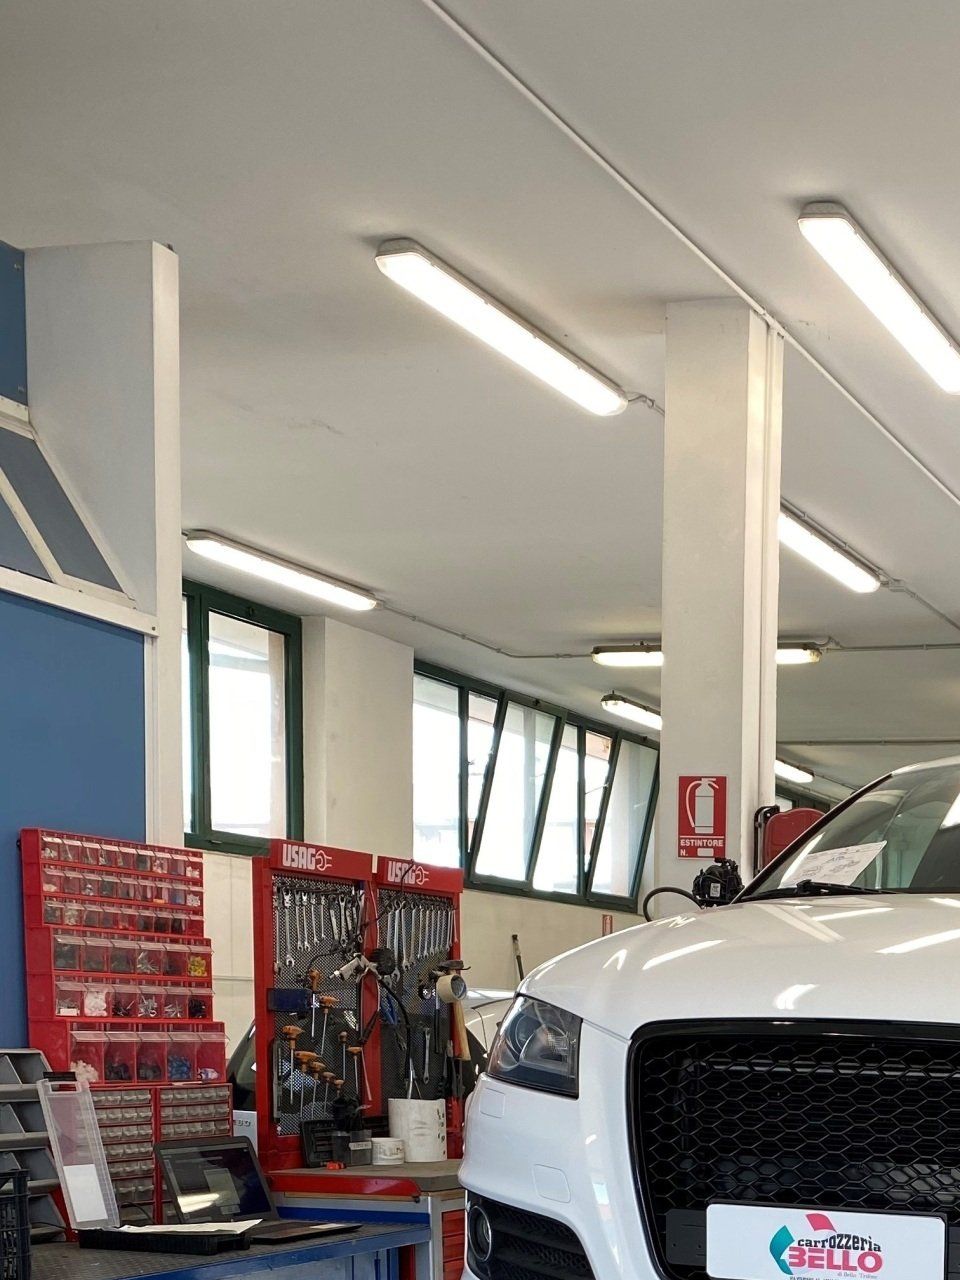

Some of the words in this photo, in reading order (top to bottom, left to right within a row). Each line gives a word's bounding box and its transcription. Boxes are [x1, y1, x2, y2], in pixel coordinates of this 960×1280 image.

[680, 839, 724, 847] ESTINTORE
[282, 843, 316, 870] USAG
[387, 860, 416, 884] USAG
[797, 1233, 882, 1252] carrozzeria
[788, 1246, 883, 1273] BELLO
